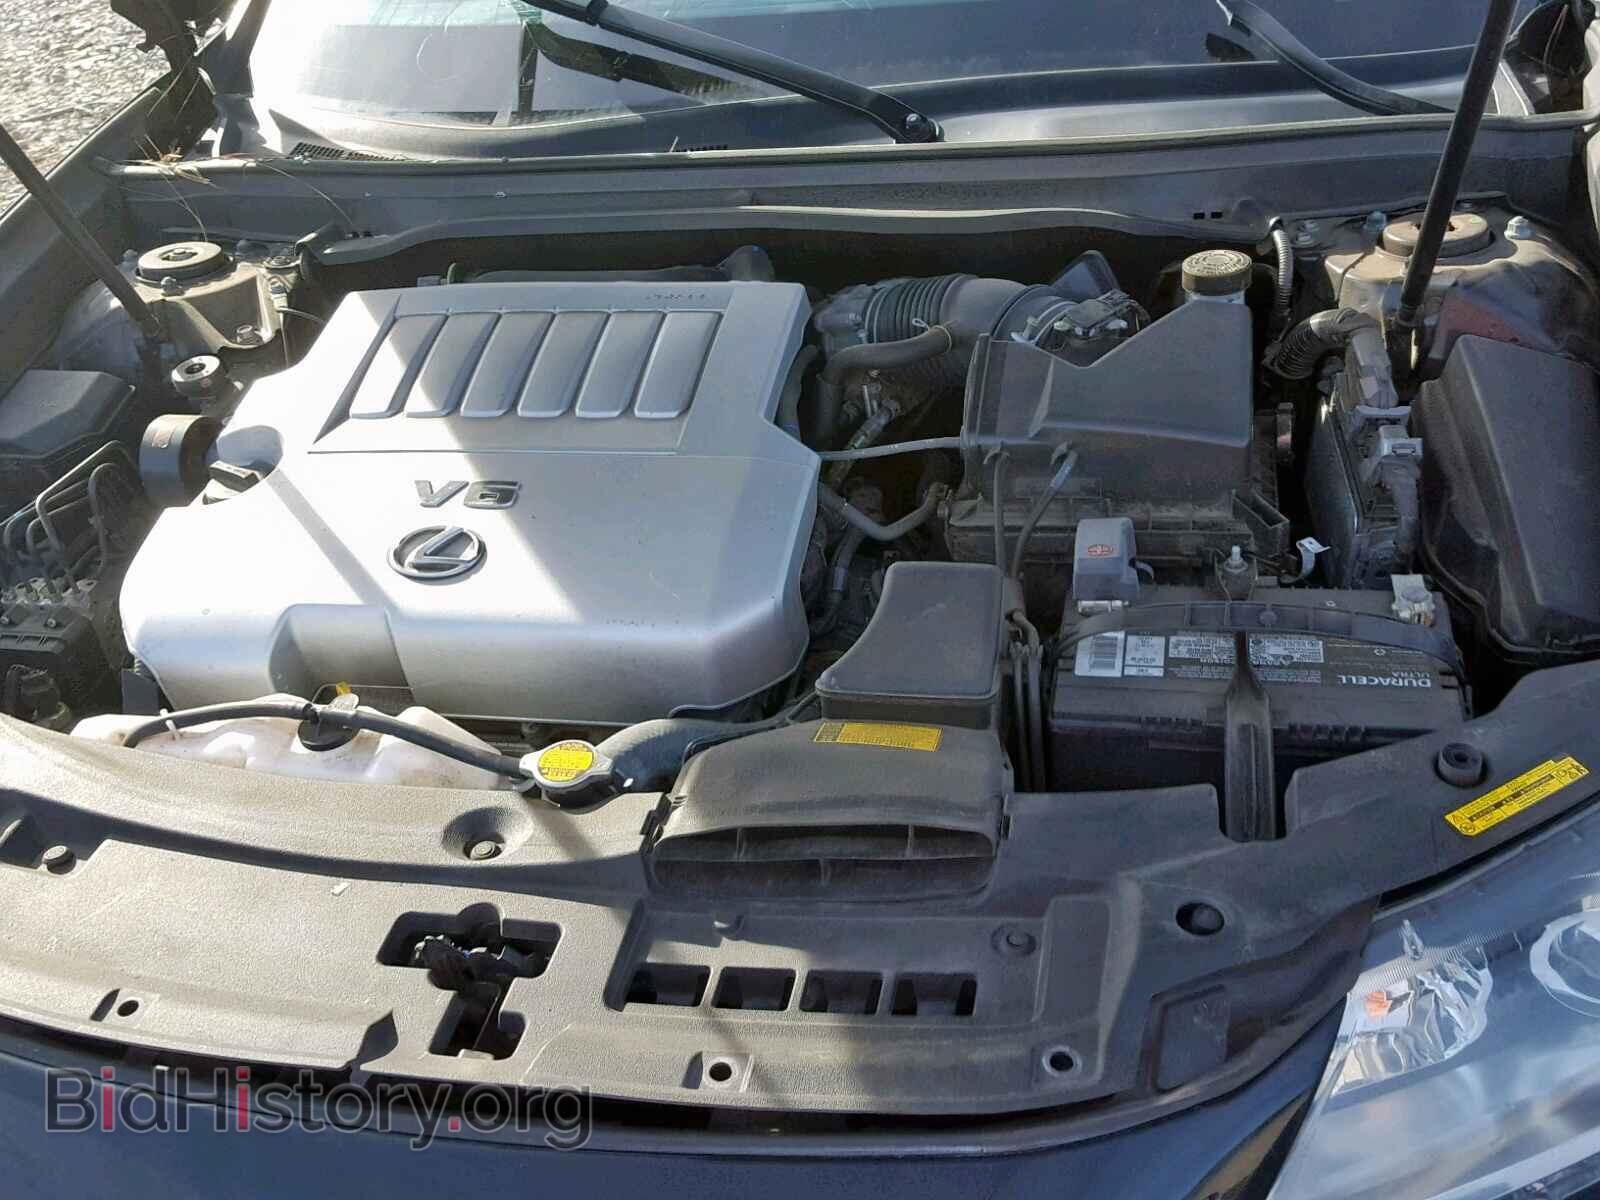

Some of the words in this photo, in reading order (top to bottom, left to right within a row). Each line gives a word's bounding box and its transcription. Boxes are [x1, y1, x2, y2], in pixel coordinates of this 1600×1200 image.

[414, 480, 521, 510] V6
[1337, 675, 1432, 688] DURACELL
[1391, 671, 1431, 679] ULTRA
